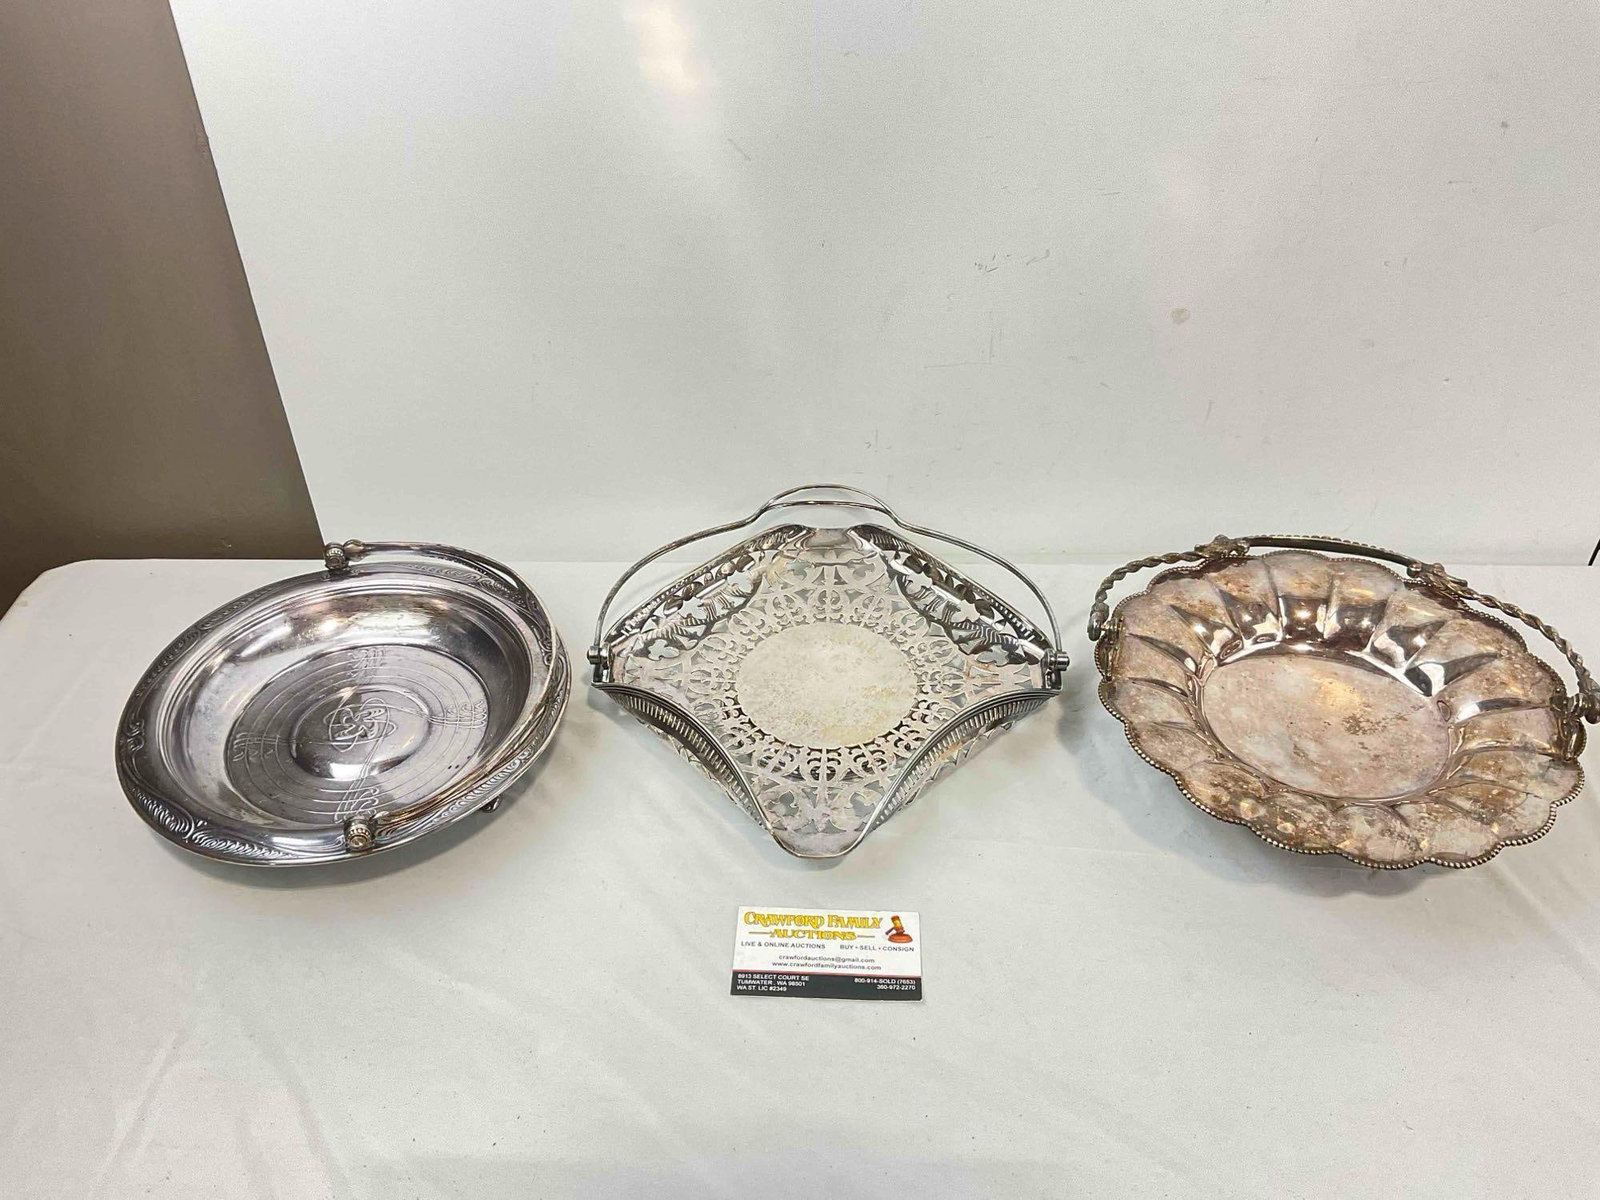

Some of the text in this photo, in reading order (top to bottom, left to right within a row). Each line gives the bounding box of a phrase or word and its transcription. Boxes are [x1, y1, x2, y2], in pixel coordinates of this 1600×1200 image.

[743, 911, 883, 929] CRAWFORD FAMILY
[769, 930, 858, 940] AUCTIONS
[778, 955, 876, 963] crawfordauctions@gmail.com
[772, 961, 882, 970] www.crawfordfamilyauctions.com
